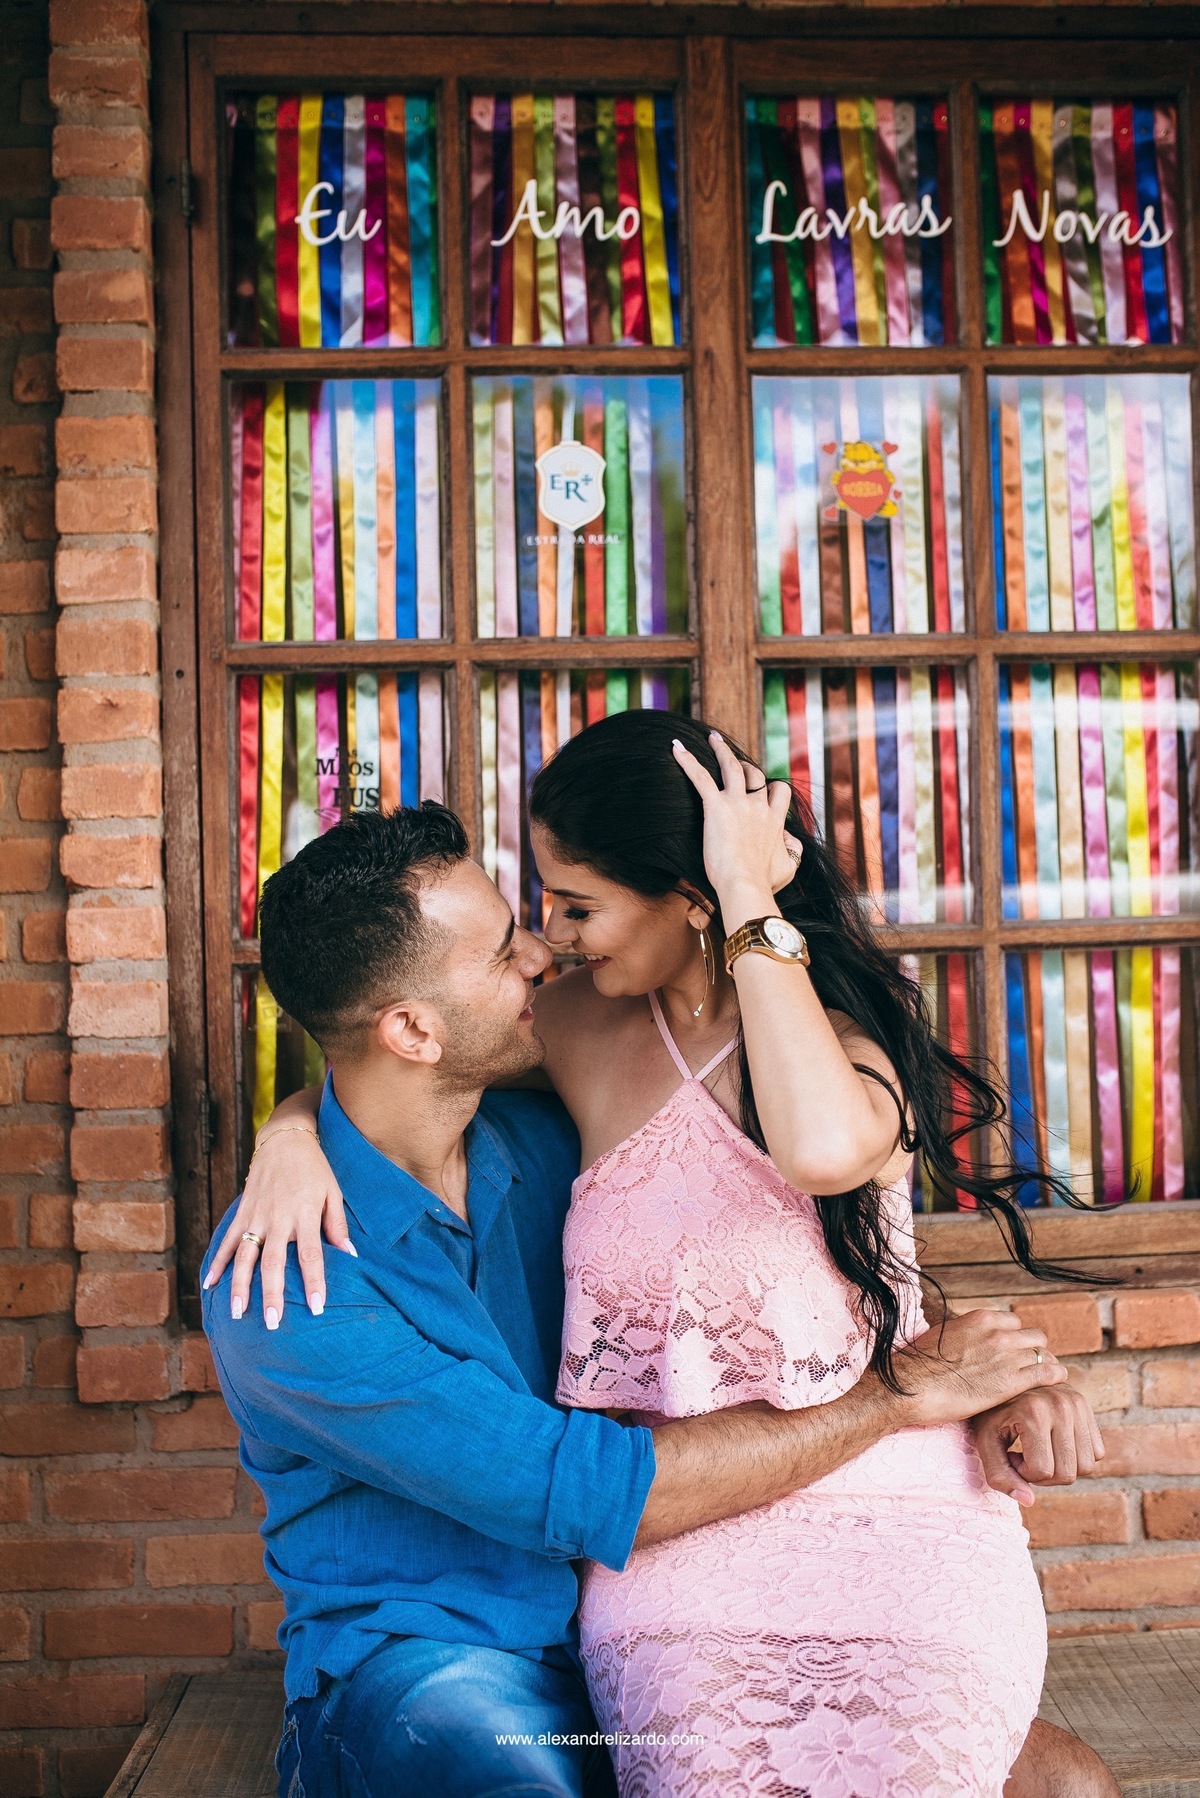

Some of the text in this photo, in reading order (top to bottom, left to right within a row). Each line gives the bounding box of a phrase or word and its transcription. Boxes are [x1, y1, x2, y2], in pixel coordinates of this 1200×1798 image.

[294, 178, 1174, 248] Eu Amo Lavras Novas
[588, 534, 621, 545] REAL
